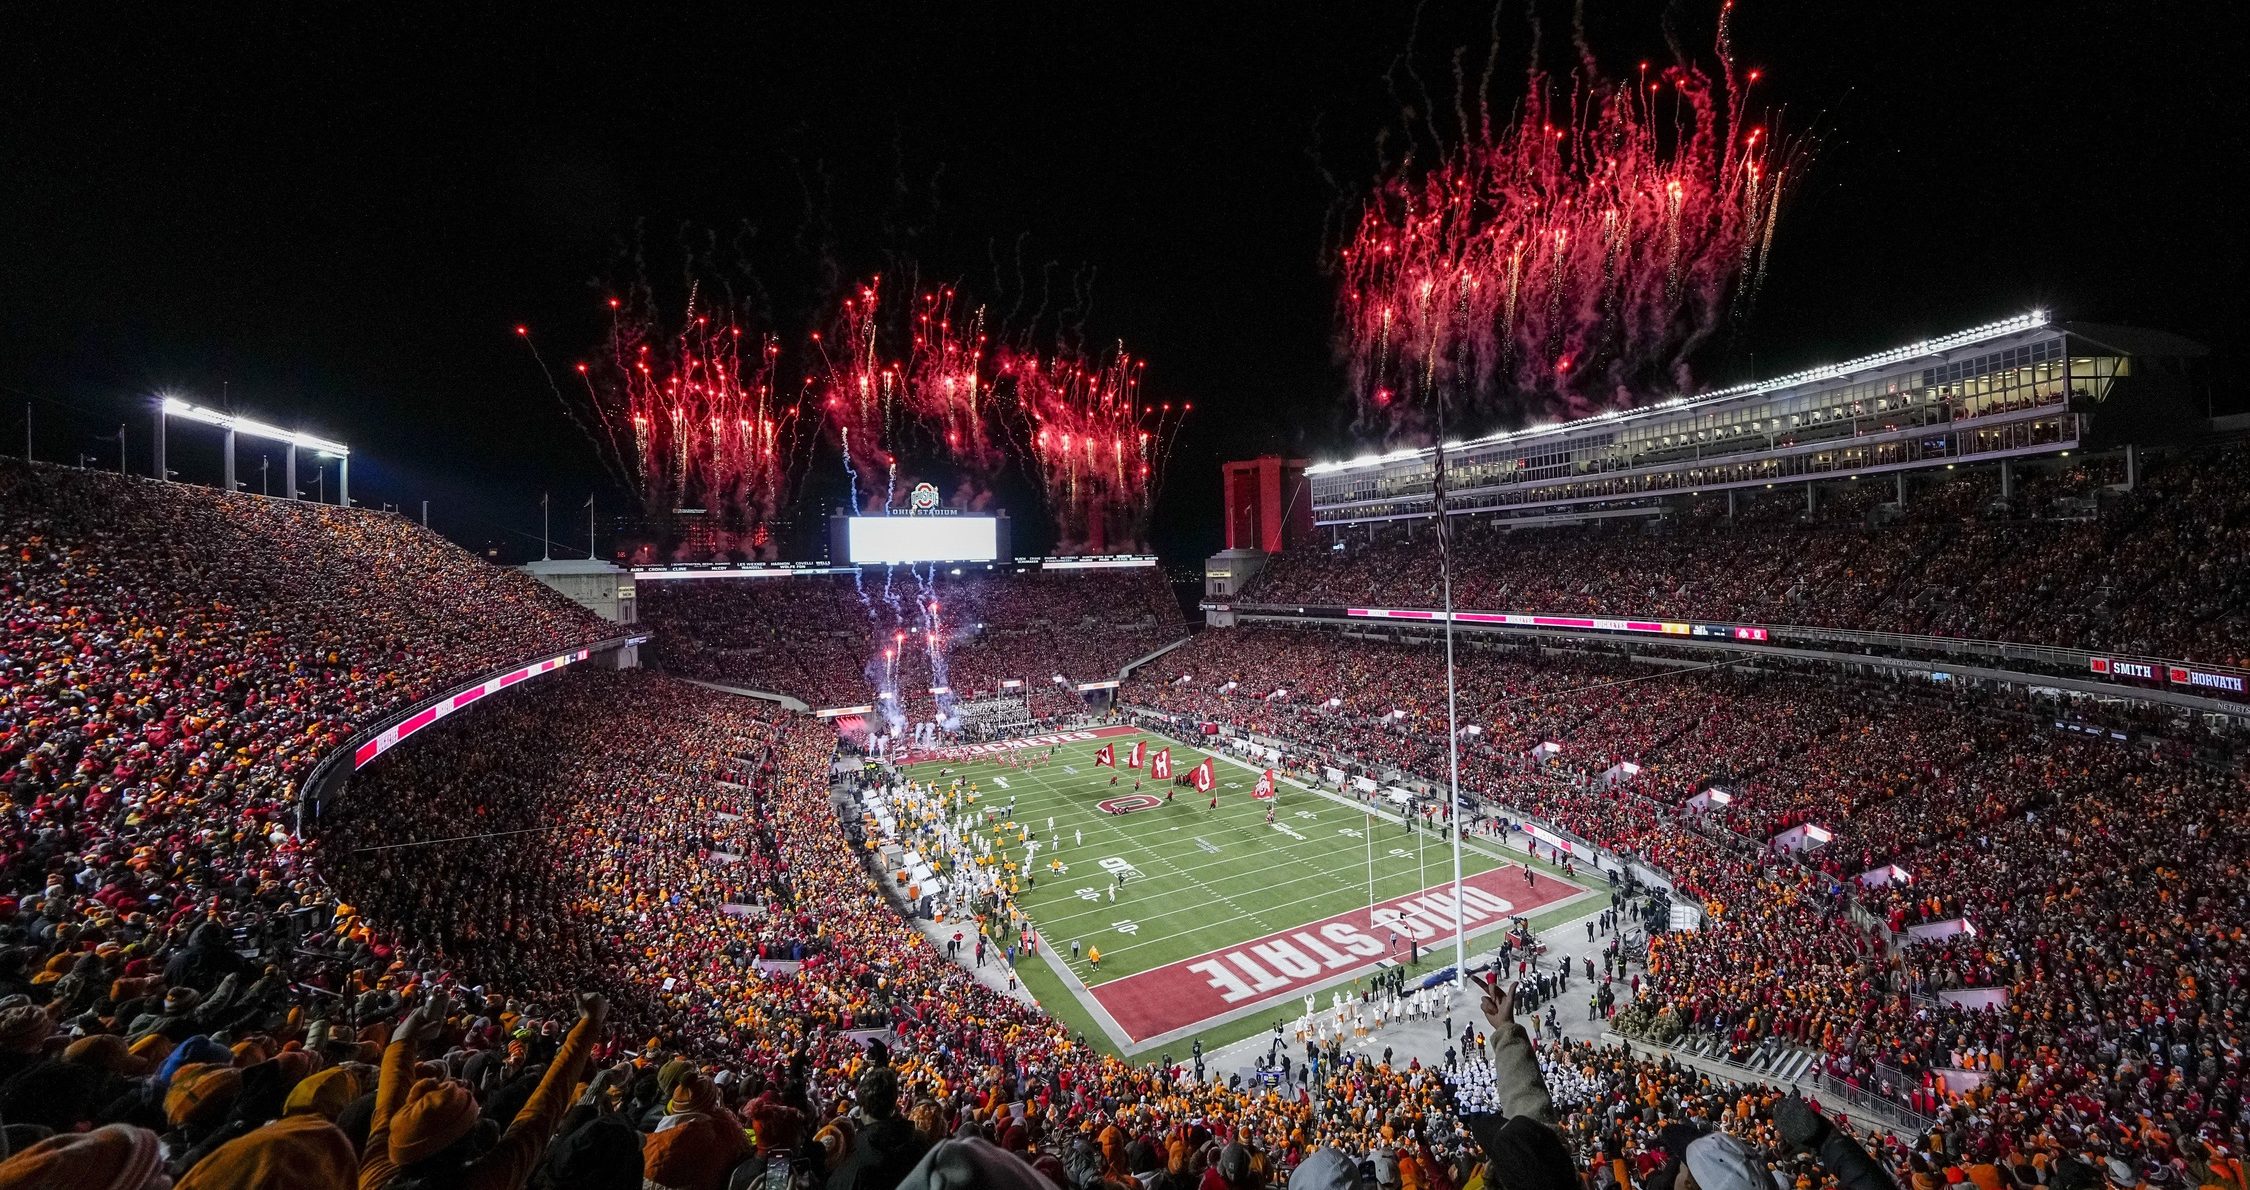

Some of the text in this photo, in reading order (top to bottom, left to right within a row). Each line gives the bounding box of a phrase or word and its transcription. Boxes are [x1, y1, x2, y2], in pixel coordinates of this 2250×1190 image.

[917, 508, 958, 516] STADIUM
[2091, 659, 2152, 678] 10 SMITH
[2190, 671, 2243, 692] HORVATH
[950, 731, 1098, 756] UCKEYES
[1155, 751, 1168, 778] H
[1198, 763, 1210, 791] O
[1074, 887, 1101, 901] 20
[1111, 919, 1139, 933] 10
[1186, 886, 1514, 1003] OHIO STATE
